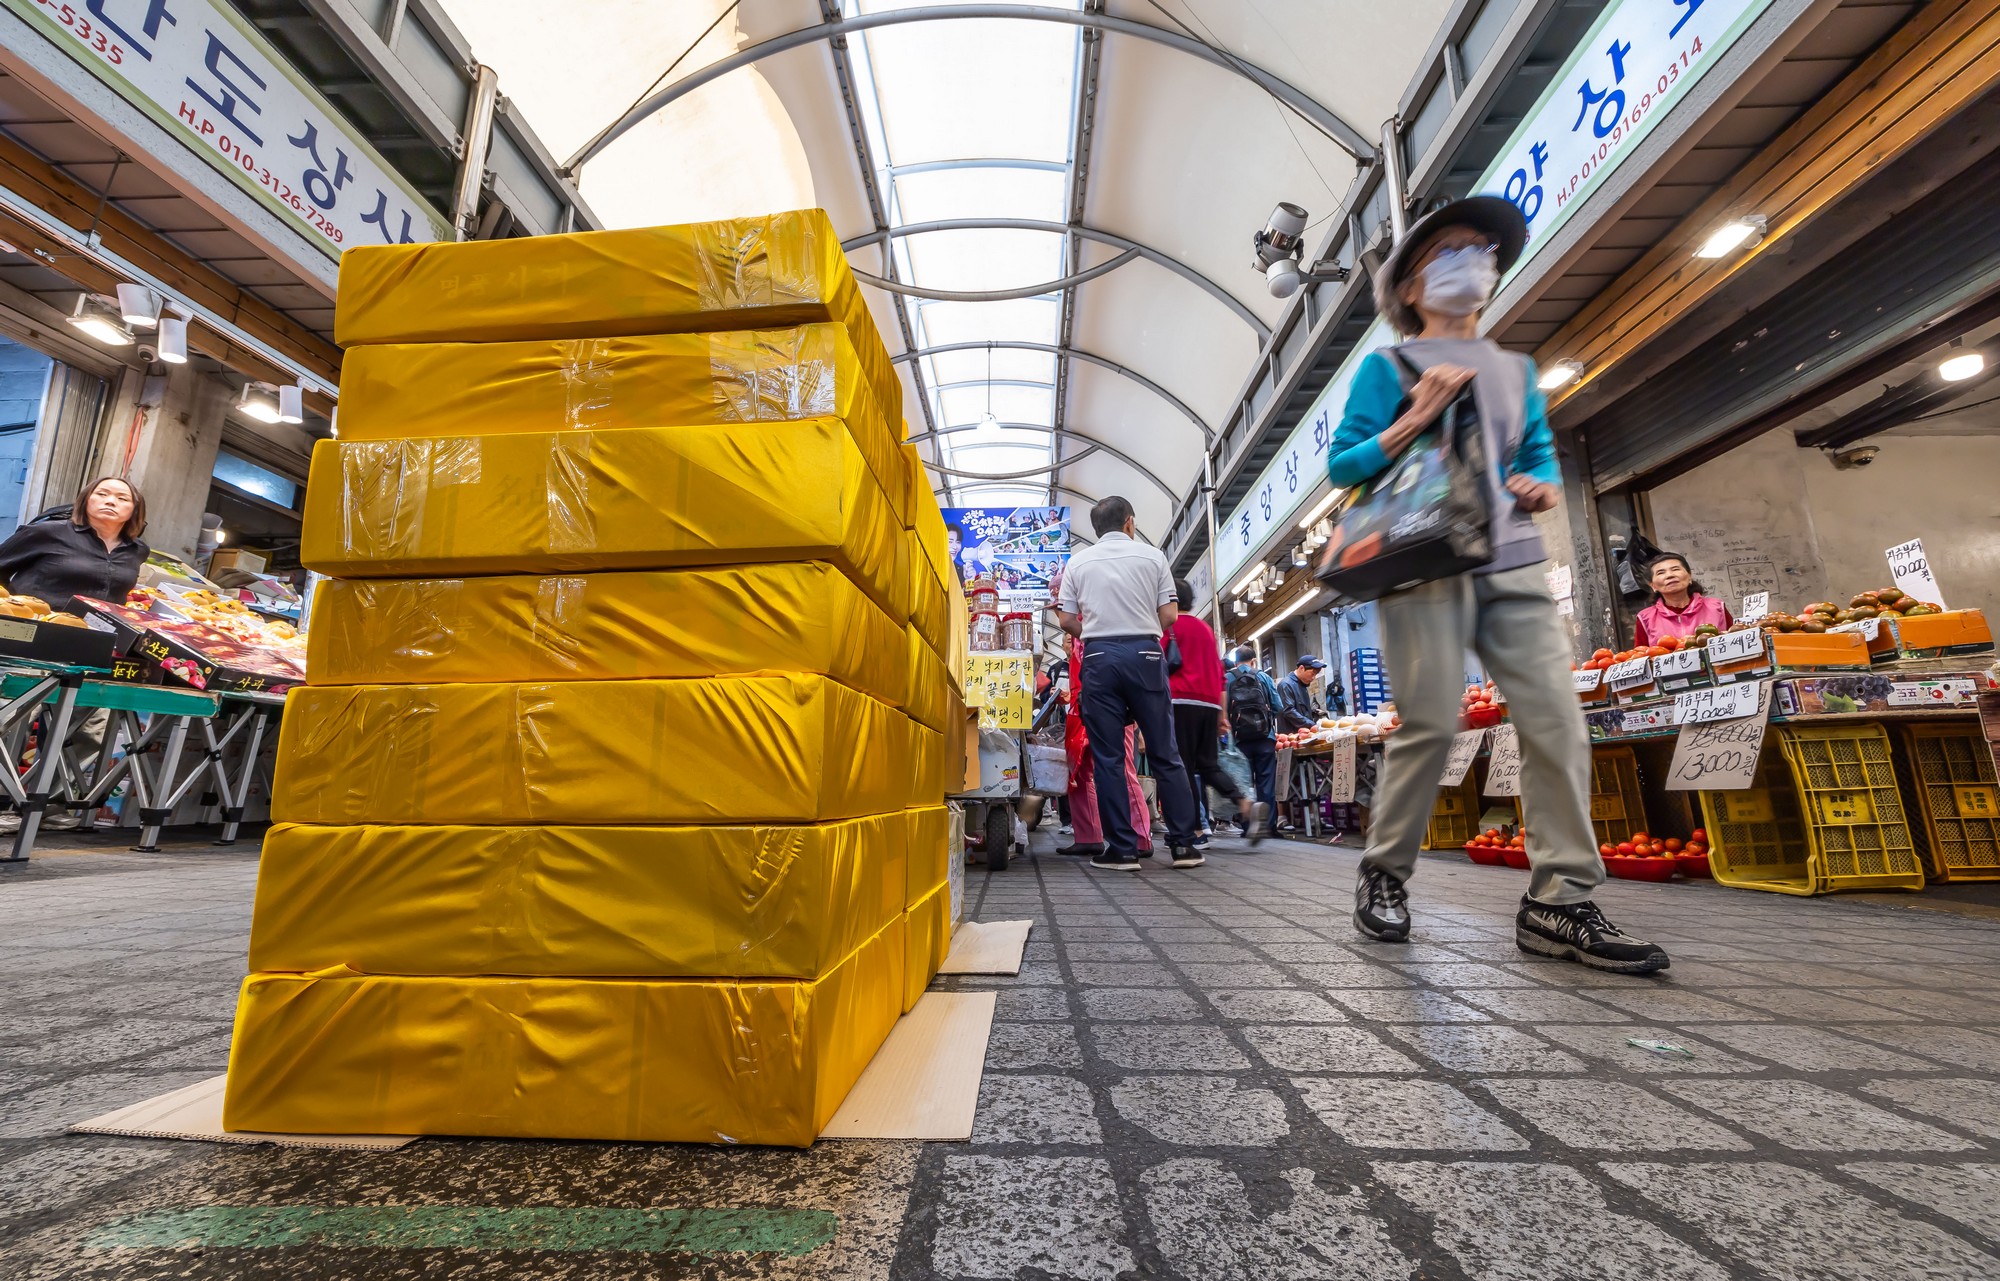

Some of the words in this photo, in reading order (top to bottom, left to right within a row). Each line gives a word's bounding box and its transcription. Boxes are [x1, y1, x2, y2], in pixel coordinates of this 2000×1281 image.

[1557, 175, 1579, 207] H.P
[1581, 35, 1703, 179] 010-9169-0314
[178, 101, 215, 136] H.P
[218, 134, 344, 244] 010-3126-7289
[1241, 409, 1330, 546] 중앙상회
[1887, 540, 1922, 563] 지금부터
[149, 641, 170, 658] 사과
[238, 676, 265, 690] 사과
[1675, 690, 1713, 708] 지금부터
